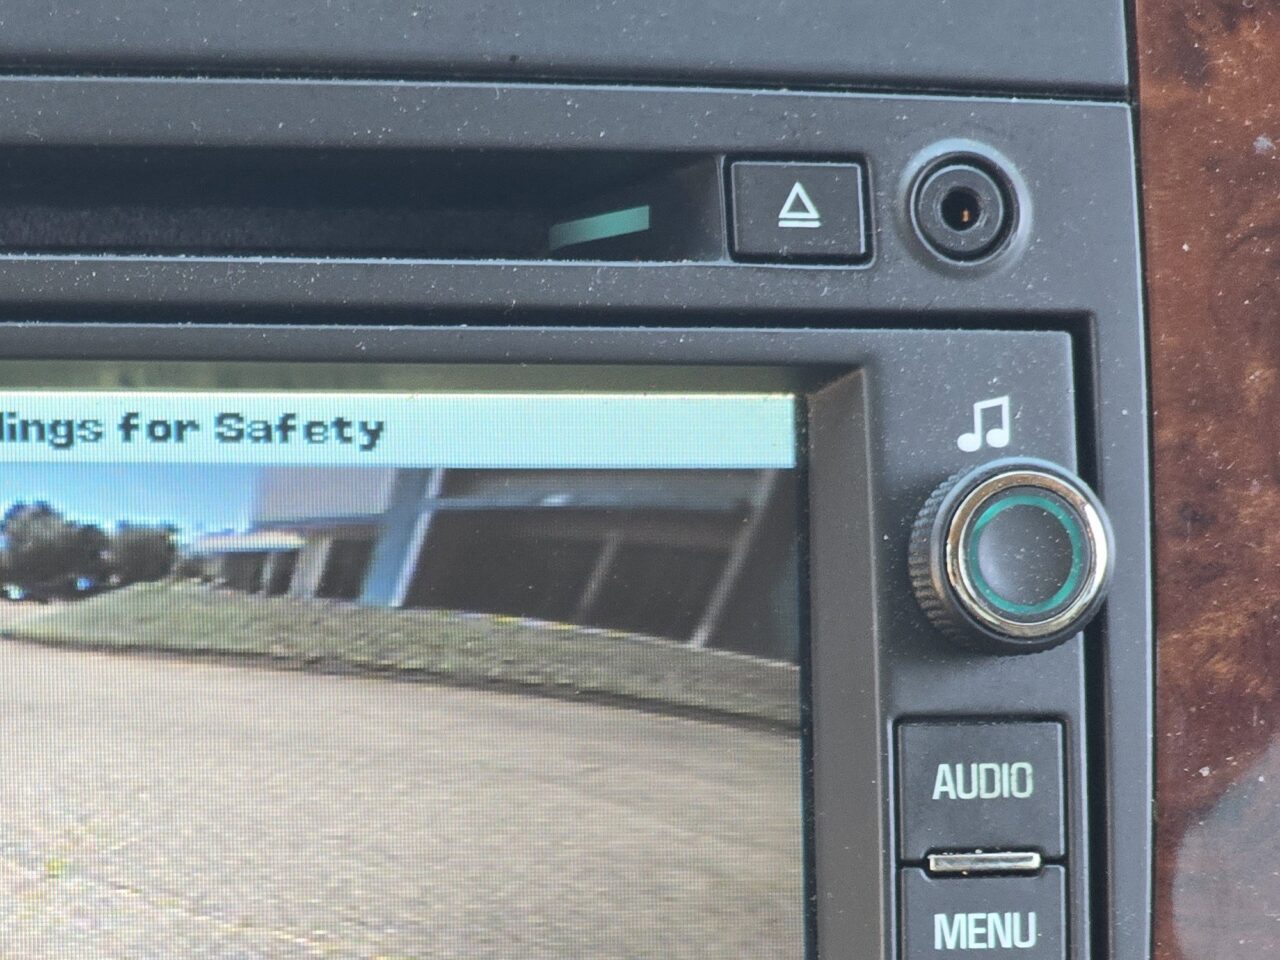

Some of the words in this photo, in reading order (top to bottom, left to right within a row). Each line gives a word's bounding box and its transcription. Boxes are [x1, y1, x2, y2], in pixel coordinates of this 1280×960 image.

[118, 411, 200, 445] for
[214, 411, 386, 451] Safety
[931, 761, 1034, 800] AUDIO
[933, 911, 1037, 951] MENU
